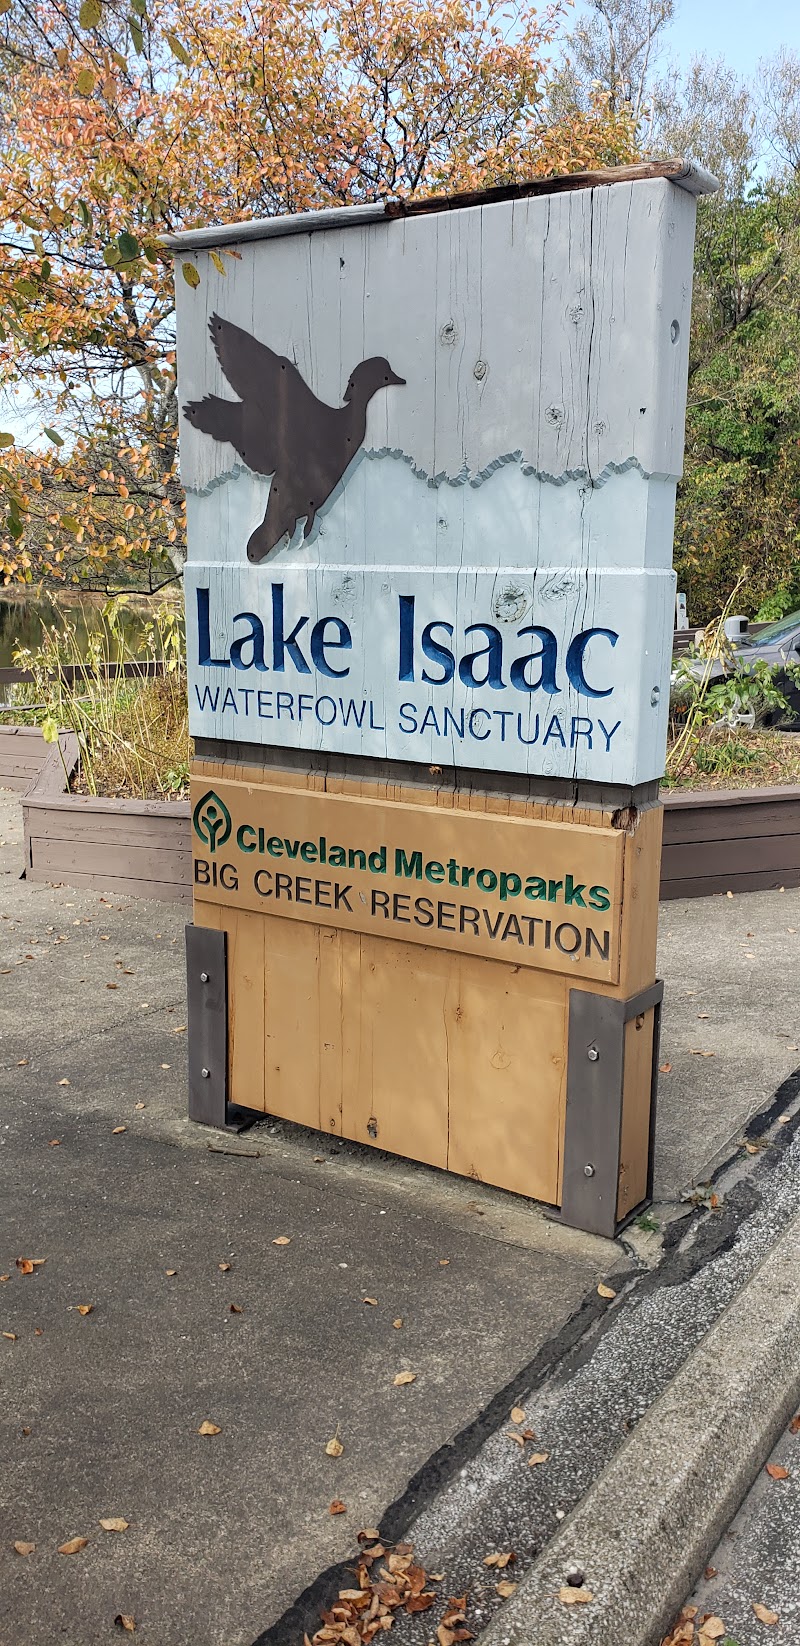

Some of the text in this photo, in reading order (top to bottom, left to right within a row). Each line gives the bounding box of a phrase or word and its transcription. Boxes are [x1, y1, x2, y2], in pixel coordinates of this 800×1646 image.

[196, 582, 620, 699] Lake Isaac
[194, 684, 622, 752] WATERFOWL SANCTUARY
[194, 858, 611, 961] BIG CREEK RESERVATION
[236, 824, 612, 912] Cleveland Metroparks
